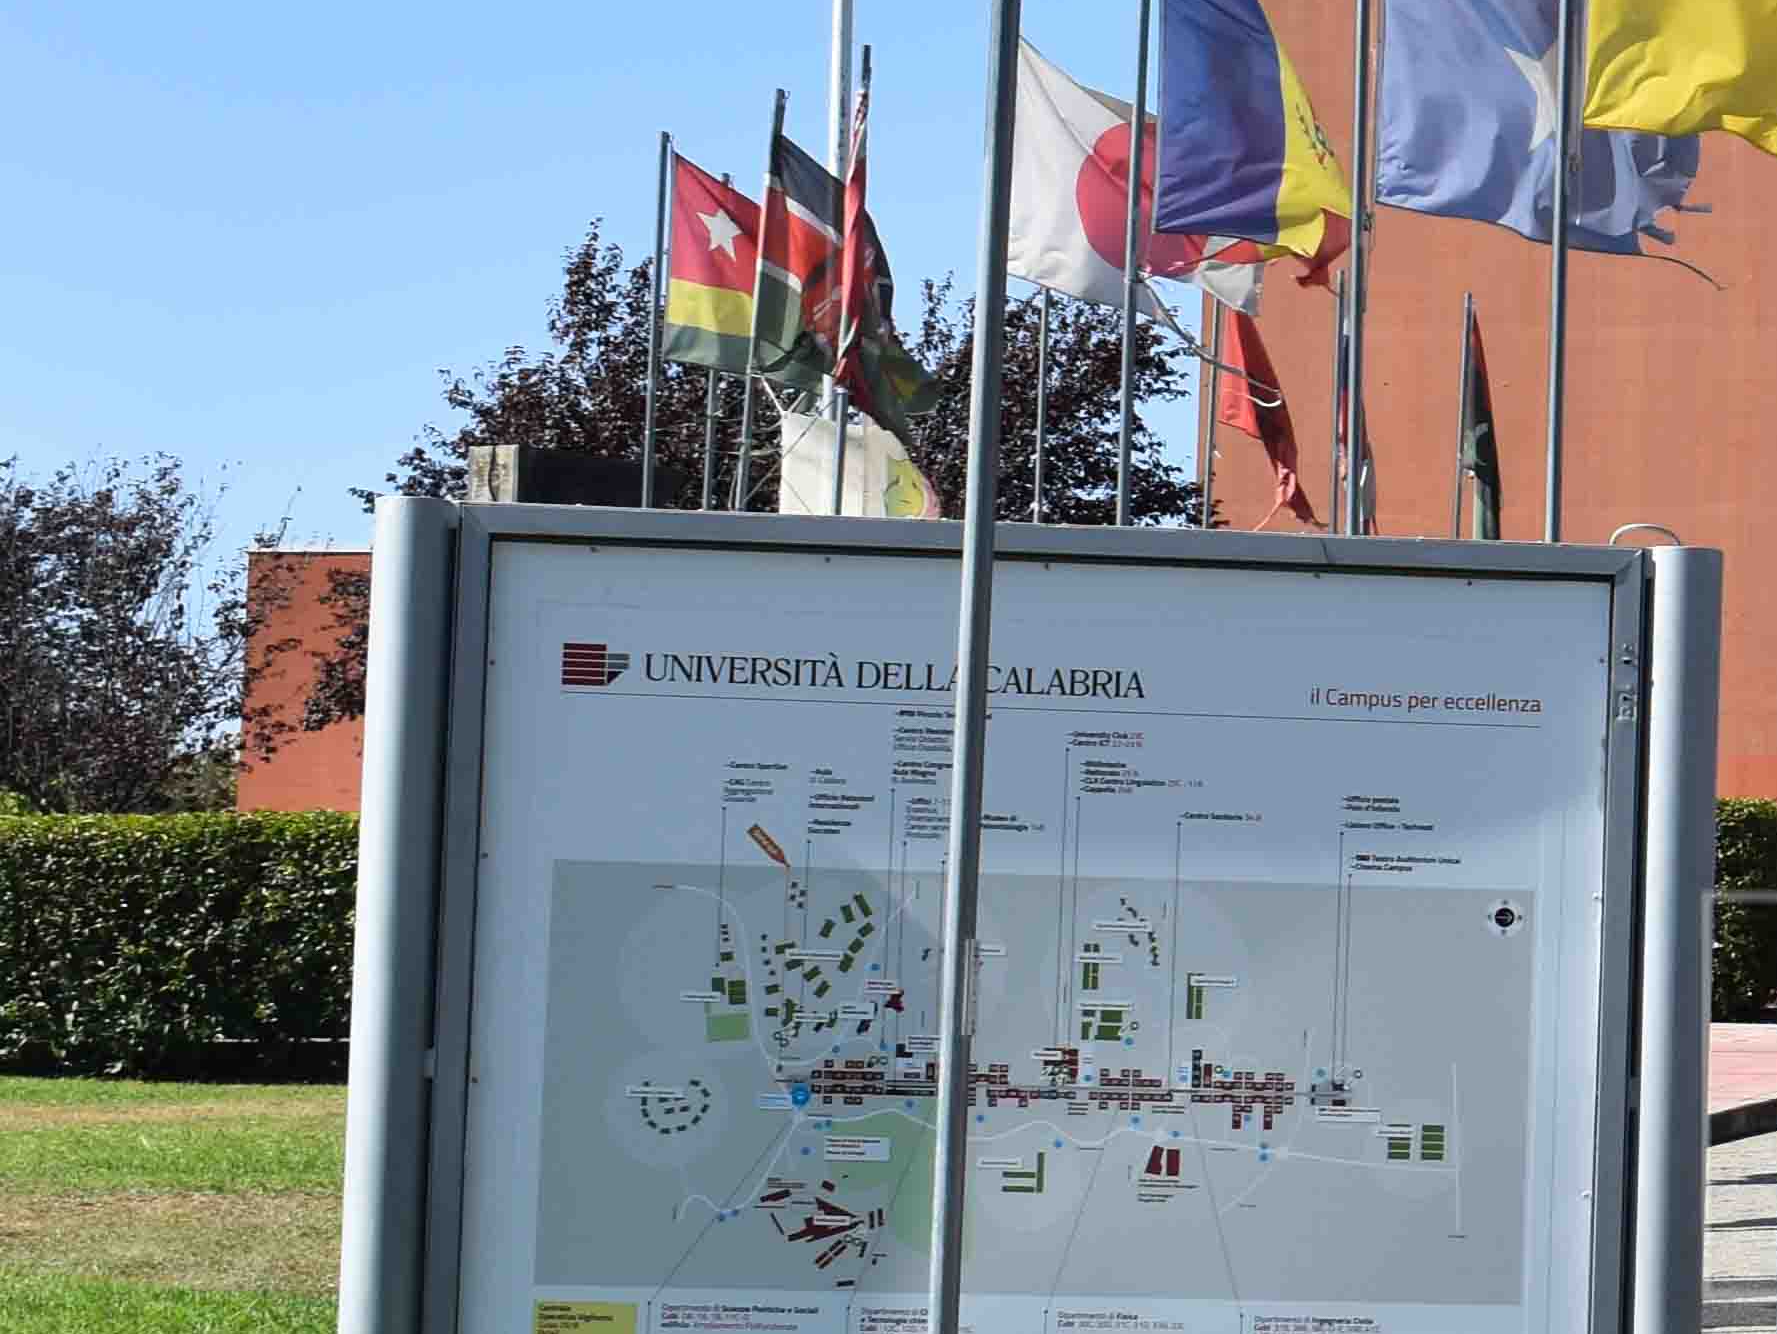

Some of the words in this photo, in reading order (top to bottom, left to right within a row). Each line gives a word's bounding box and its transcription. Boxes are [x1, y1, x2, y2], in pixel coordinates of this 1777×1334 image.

[645, 652, 844, 688] UNIVERSITÀ
[1311, 686, 1320, 706] il
[1326, 688, 1401, 712] Campus
[1408, 693, 1438, 713] per
[1444, 691, 1542, 713] eccellenza
